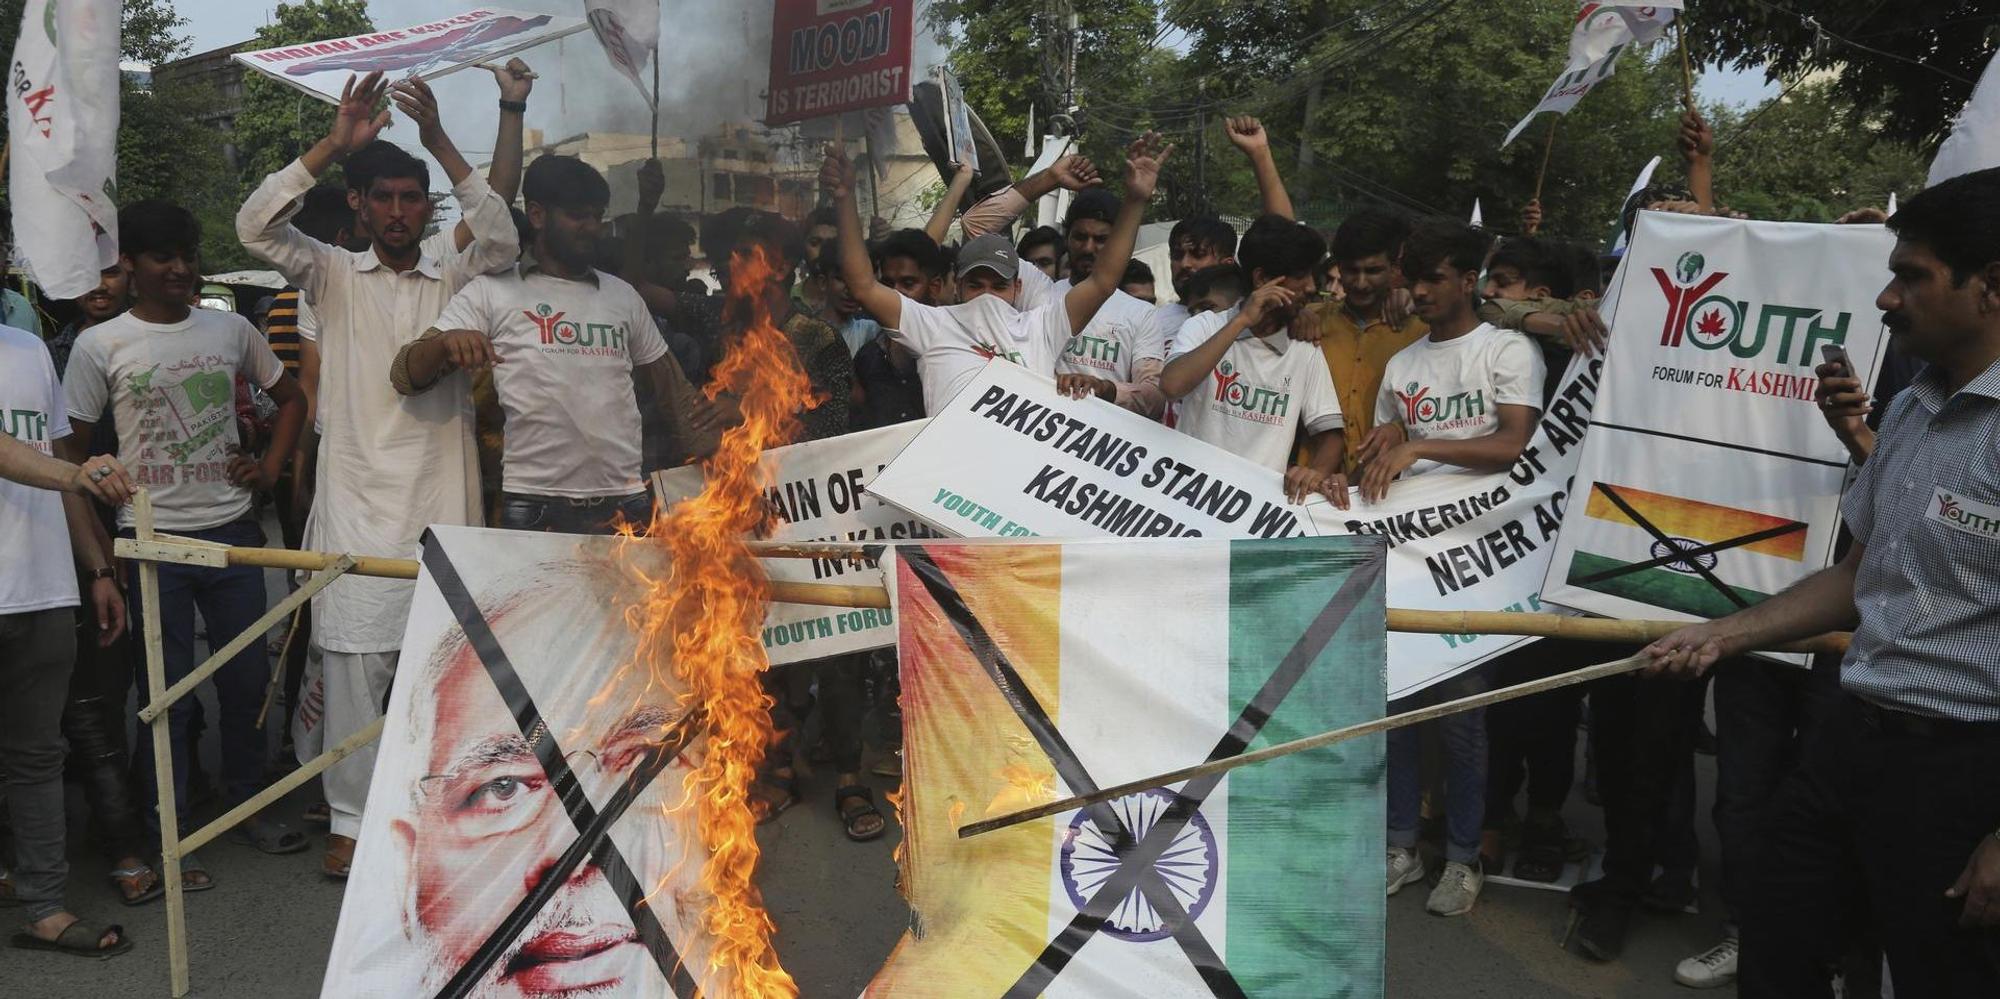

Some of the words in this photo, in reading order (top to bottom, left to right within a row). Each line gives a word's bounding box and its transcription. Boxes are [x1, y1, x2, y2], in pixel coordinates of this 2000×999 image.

[253, 40, 354, 63] INDIAN
[789, 7, 892, 75] MOODI
[771, 89, 790, 115] IS
[793, 66, 904, 111] TERRIORIST
[522, 310, 626, 352] YOUTH
[1650, 267, 1852, 366] YOUTH
[1213, 368, 1290, 417] YOUTH
[1541, 347, 1606, 457] ARTIC
[1651, 366, 1694, 385] FORUM
[1696, 372, 1724, 389] FOR
[1725, 366, 1817, 402] KASHMI
[1394, 387, 1485, 425] YOUTH
[1436, 416, 1486, 432] KASHMIR
[181, 461, 227, 485] FOR
[969, 384, 1148, 478] PAKISTANIS
[1143, 456, 1253, 524] STAND
[763, 478, 822, 524] AIN
[827, 468, 865, 515] OF
[932, 488, 1003, 531] YOUTH
[1937, 494, 2000, 534] YOUTH
[1424, 519, 1538, 597] NEVER
[762, 617, 834, 647] YOUTH
[836, 608, 893, 635] FORU
